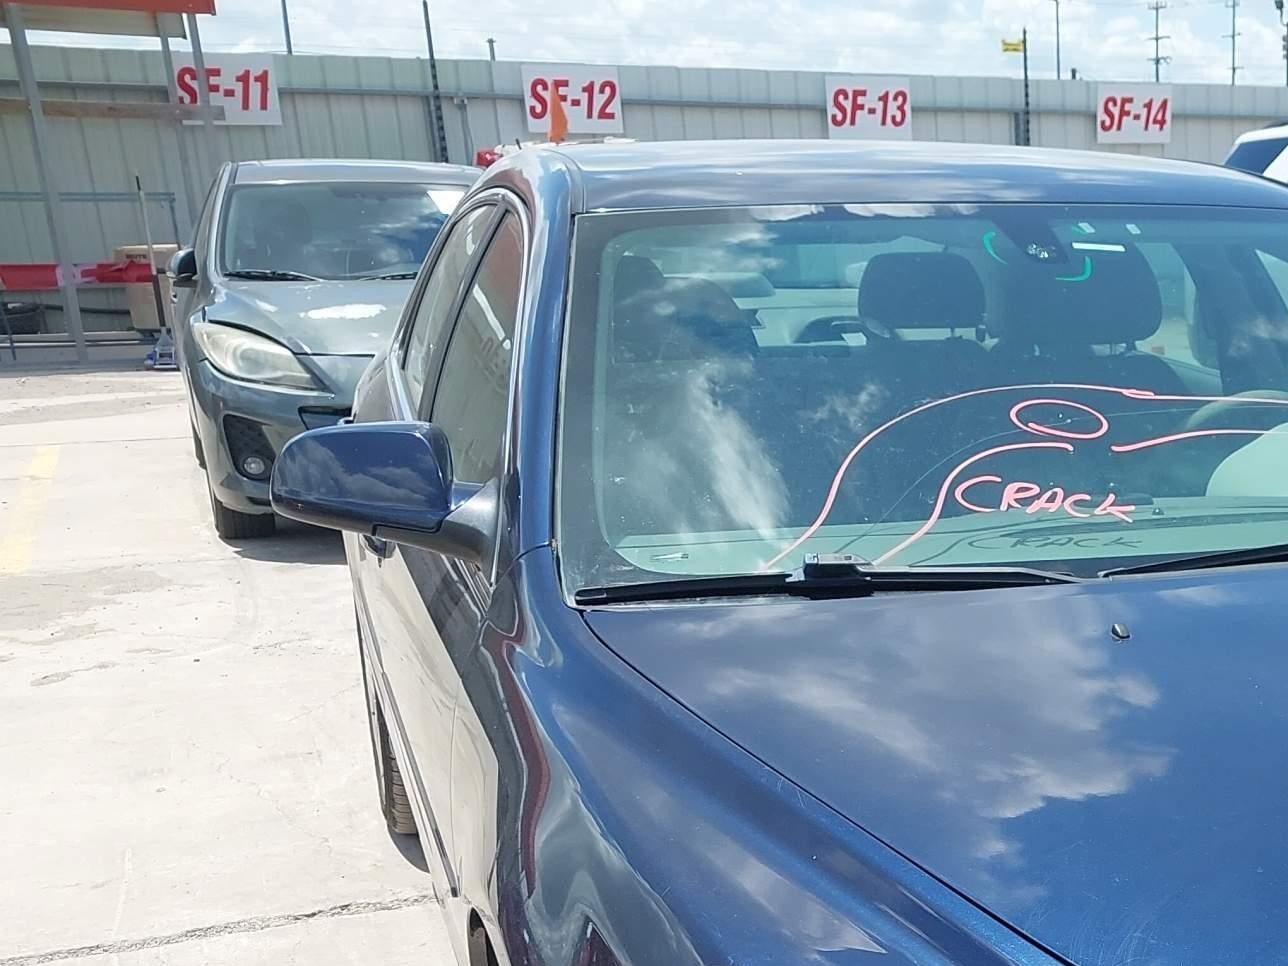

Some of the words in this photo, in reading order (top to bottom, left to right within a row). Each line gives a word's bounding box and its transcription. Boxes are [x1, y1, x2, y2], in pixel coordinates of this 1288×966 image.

[176, 66, 269, 111] SF-11
[831, 88, 908, 127] SF-13
[1100, 96, 1169, 132] SF-14
[954, 474, 1137, 523] CRACK
